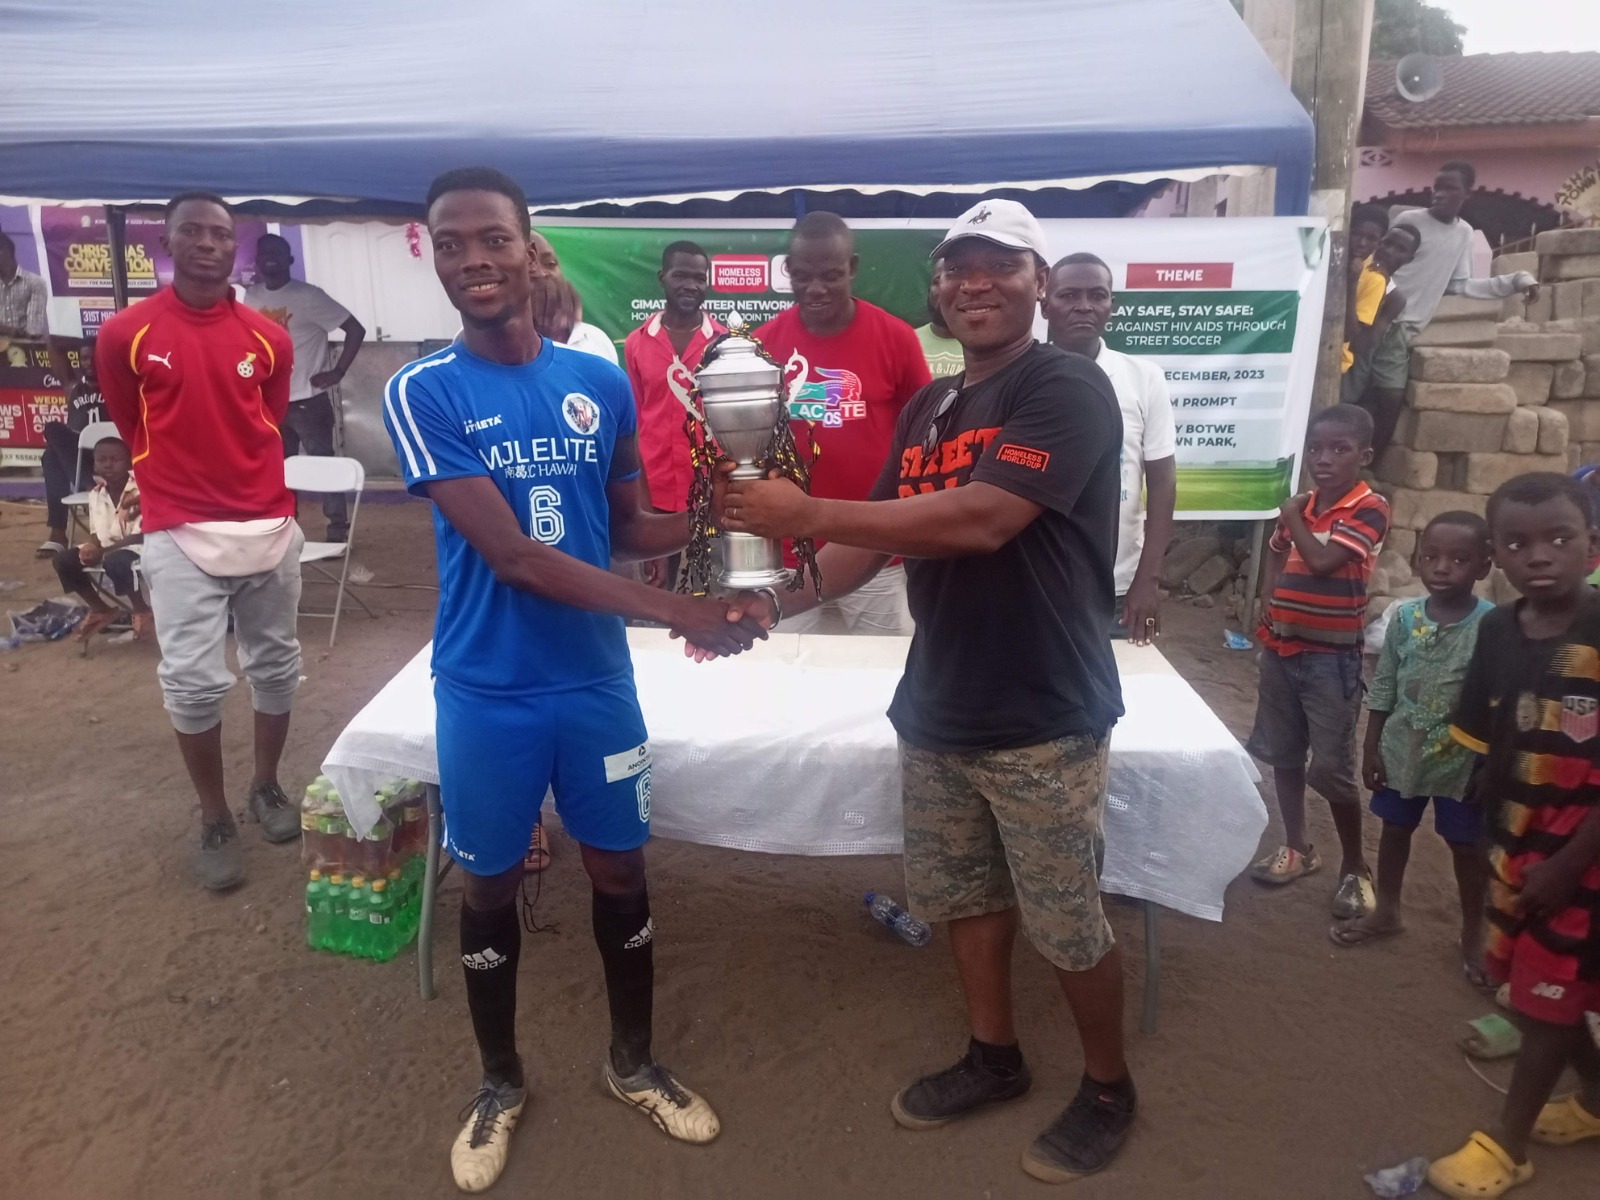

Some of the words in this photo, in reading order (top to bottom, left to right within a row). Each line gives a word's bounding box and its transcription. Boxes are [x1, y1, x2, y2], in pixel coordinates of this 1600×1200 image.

[68, 244, 145, 258] CHRISAS
[64, 257, 154, 272] CONVEION
[718, 268, 761, 277] HOMELESS
[1156, 270, 1203, 281] THEME
[717, 277, 746, 286] WORLD
[746, 277, 762, 286] CUP
[700, 300, 735, 310] NTEER
[737, 300, 795, 310] NETWORK
[82, 311, 100, 322] 31ST
[741, 313, 761, 321] JOIN
[1137, 306, 1175, 318] SAFE,
[1178, 305, 1212, 316] STAY
[1215, 305, 1254, 316] SAFE:
[1116, 322, 1168, 332] AGAINST
[1171, 322, 1192, 332] HIV
[1194, 321, 1223, 332] AIDS
[1226, 320, 1286, 331] THROUGH
[1126, 336, 1170, 346] STREET
[1172, 335, 1222, 346] SOCCER
[1164, 371, 1230, 381] ECEMBER,
[1234, 370, 1265, 380] 2023
[1182, 397, 1237, 407] PROMPT
[1186, 424, 1235, 434] BOTWE
[1197, 437, 1237, 448] PARK,
[1004, 448, 1042, 463] HOMELESS
[1001, 454, 1026, 466] WORLD
[1026, 459, 1042, 470] CUP
[529, 485, 565, 545] 6
[636, 768, 651, 823] 6
